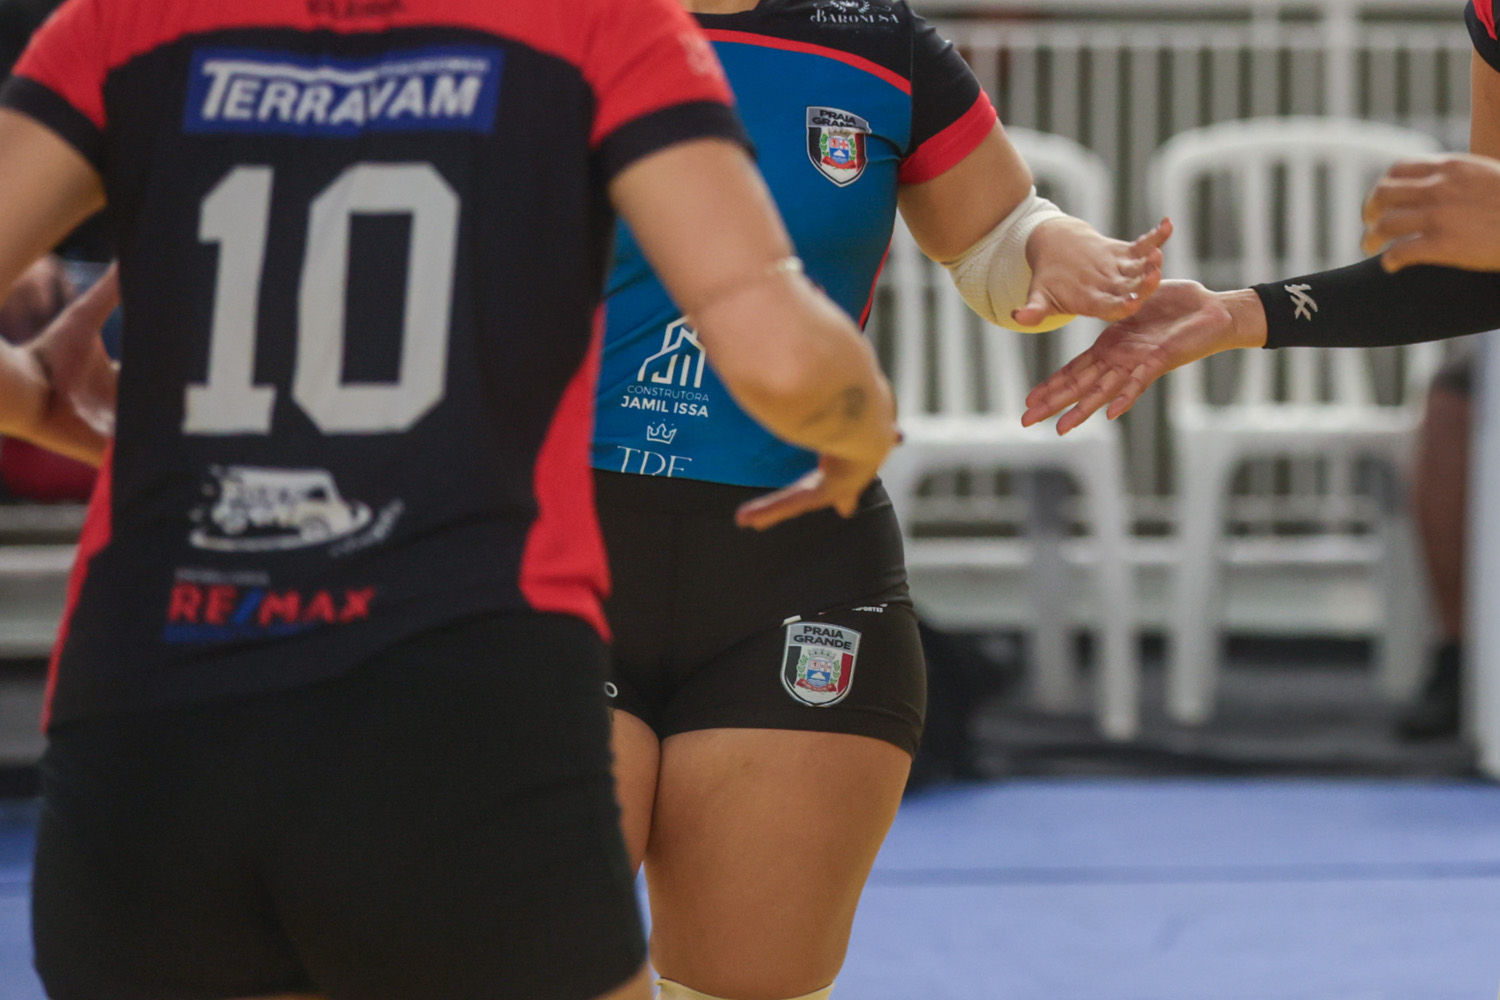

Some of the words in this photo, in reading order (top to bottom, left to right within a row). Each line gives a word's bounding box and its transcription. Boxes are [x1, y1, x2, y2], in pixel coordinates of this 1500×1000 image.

[203, 59, 482, 126] TERRAVAM
[820, 109, 856, 126] PRAIA
[182, 161, 461, 435] 10
[627, 385, 710, 403] CONSTRUTORA
[621, 395, 669, 413] JAMIL
[673, 401, 709, 418] ISSA
[168, 582, 376, 627] RE/MAX
[793, 634, 852, 650] GRANDE
[803, 625, 844, 640] PRAIA
